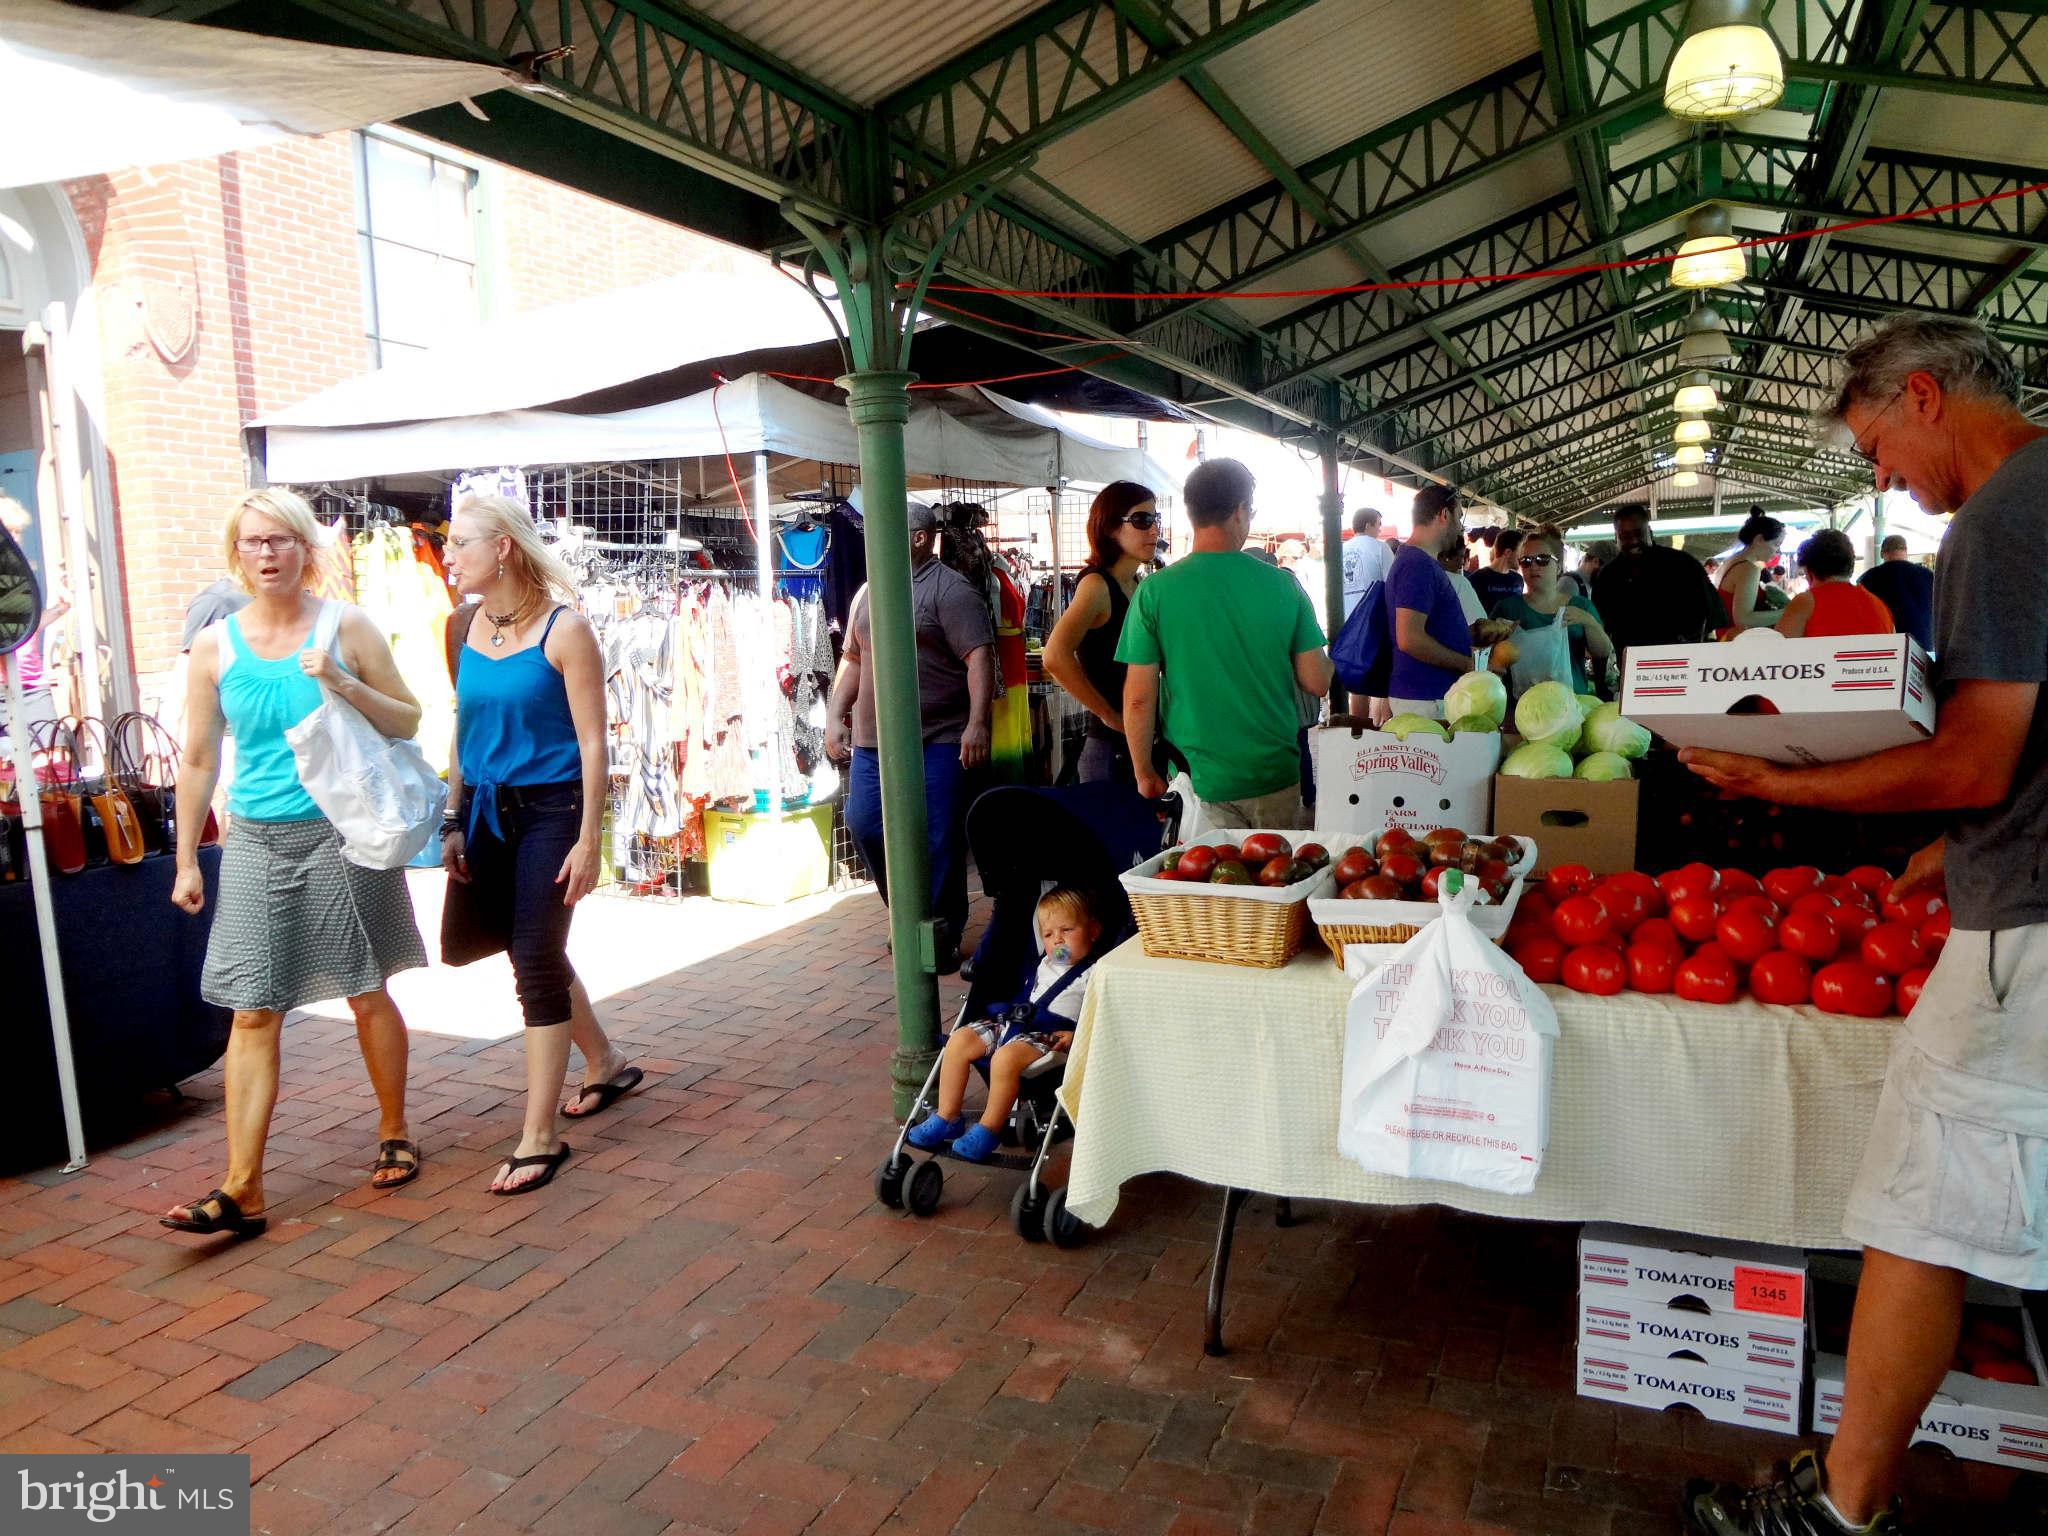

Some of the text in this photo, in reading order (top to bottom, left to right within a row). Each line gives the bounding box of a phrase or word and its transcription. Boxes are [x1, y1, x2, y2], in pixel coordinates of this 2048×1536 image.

[1698, 663, 1826, 683] TOMATOES
[1357, 754, 1439, 779] Spring Valley
[1385, 809, 1417, 817] FARM
[1474, 970, 1522, 1001] YOU
[1472, 1001, 1526, 1032] YOU
[1472, 1030, 1526, 1062] YOU
[1407, 1127, 1432, 1140] REUSE
[1432, 1130, 1445, 1141] OR
[1445, 1132, 1481, 1146] RECYCLE
[1483, 1137, 1500, 1149] THIS
[1501, 1139, 1519, 1152] BAG
[1635, 1267, 1735, 1292] TOMATOES
[1751, 1286, 1787, 1301] 1345
[1637, 1321, 1740, 1349] TOMATOES
[1634, 1373, 1736, 1402] TOMATOES
[1919, 1420, 1990, 1441] ATOES
